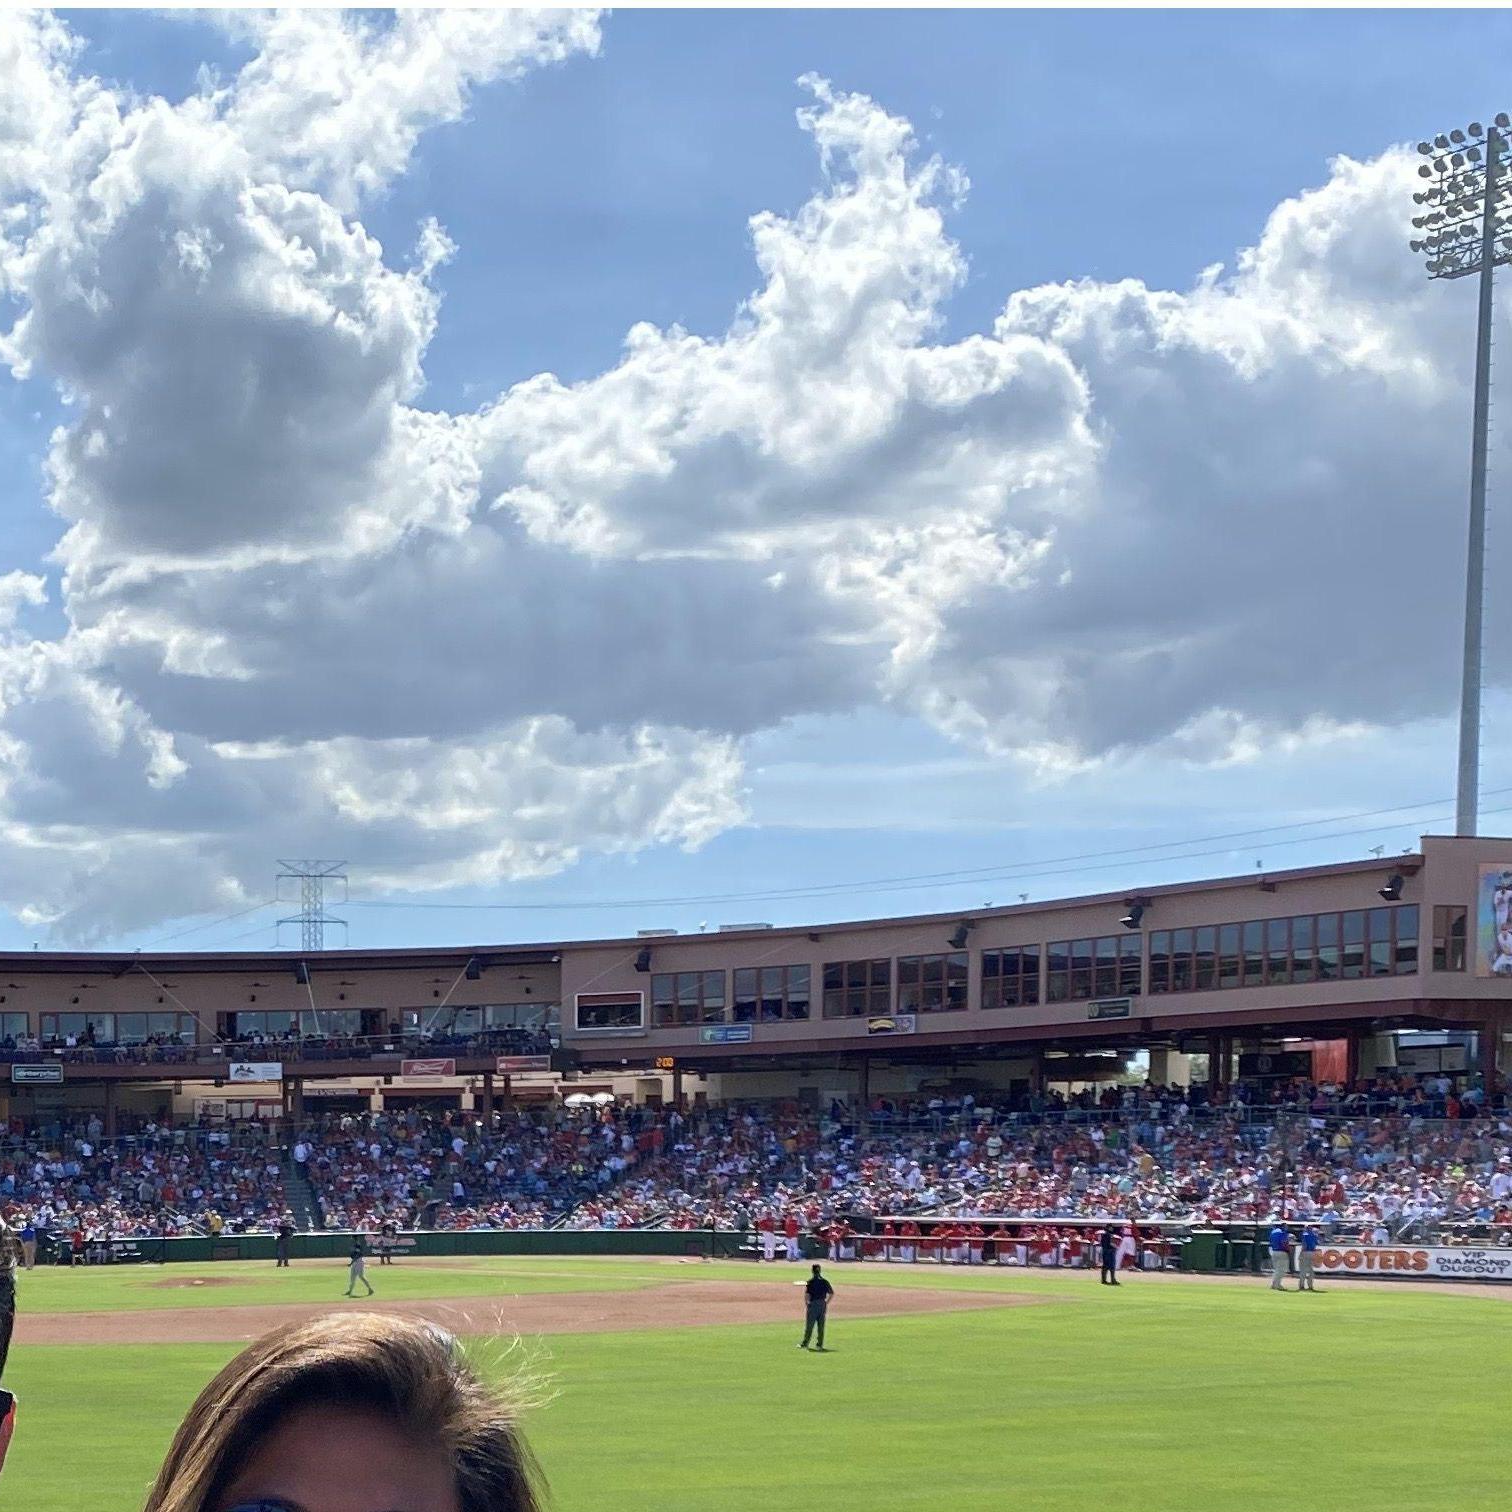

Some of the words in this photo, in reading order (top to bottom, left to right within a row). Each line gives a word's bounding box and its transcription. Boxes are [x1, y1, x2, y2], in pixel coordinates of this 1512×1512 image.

[1461, 1250, 1487, 1259] VIP
[1436, 1257, 1512, 1268] DIAMOND
[1439, 1264, 1505, 1275] DUGOUT
